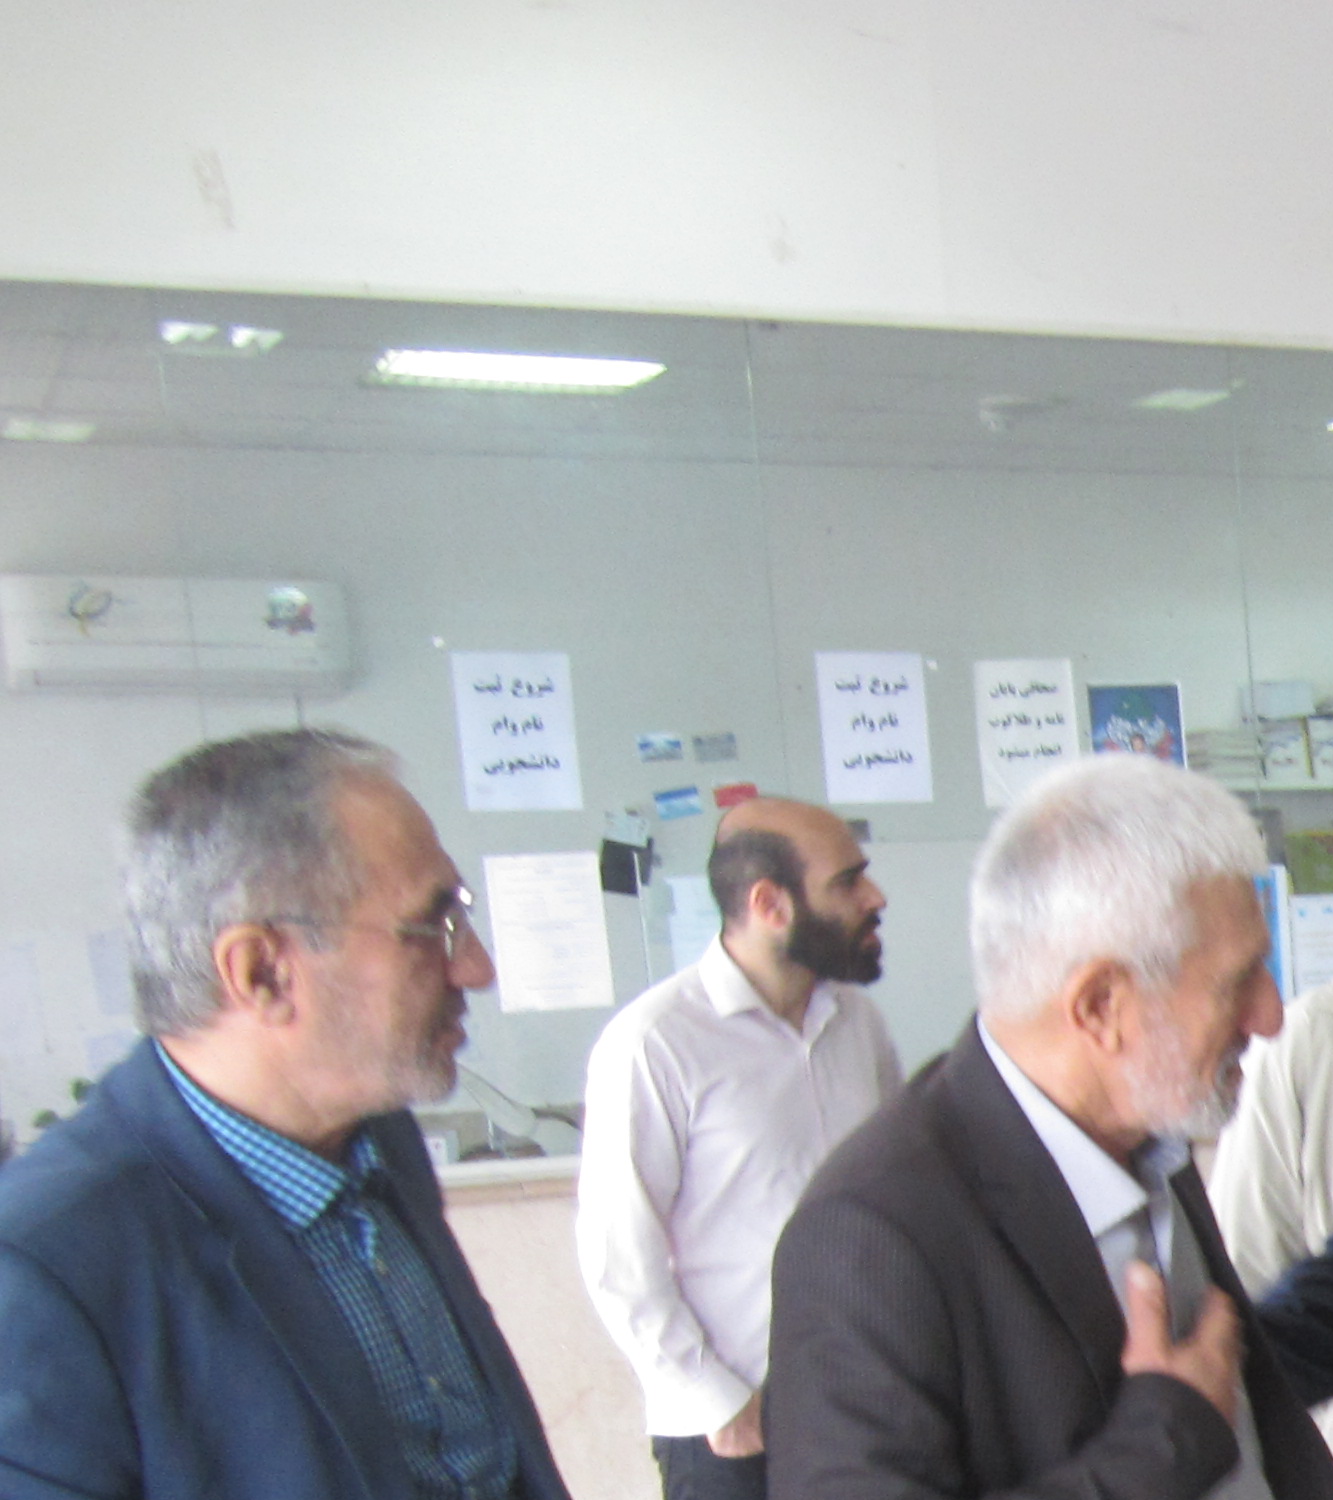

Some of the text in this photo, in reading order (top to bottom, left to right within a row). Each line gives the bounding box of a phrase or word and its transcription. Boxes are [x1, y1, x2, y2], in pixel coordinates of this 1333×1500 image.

[473, 674, 555, 698] شروع ثبت
[834, 675, 910, 696] شروع ثبت
[522, 716, 543, 735] نام
[879, 712, 899, 731] نام
